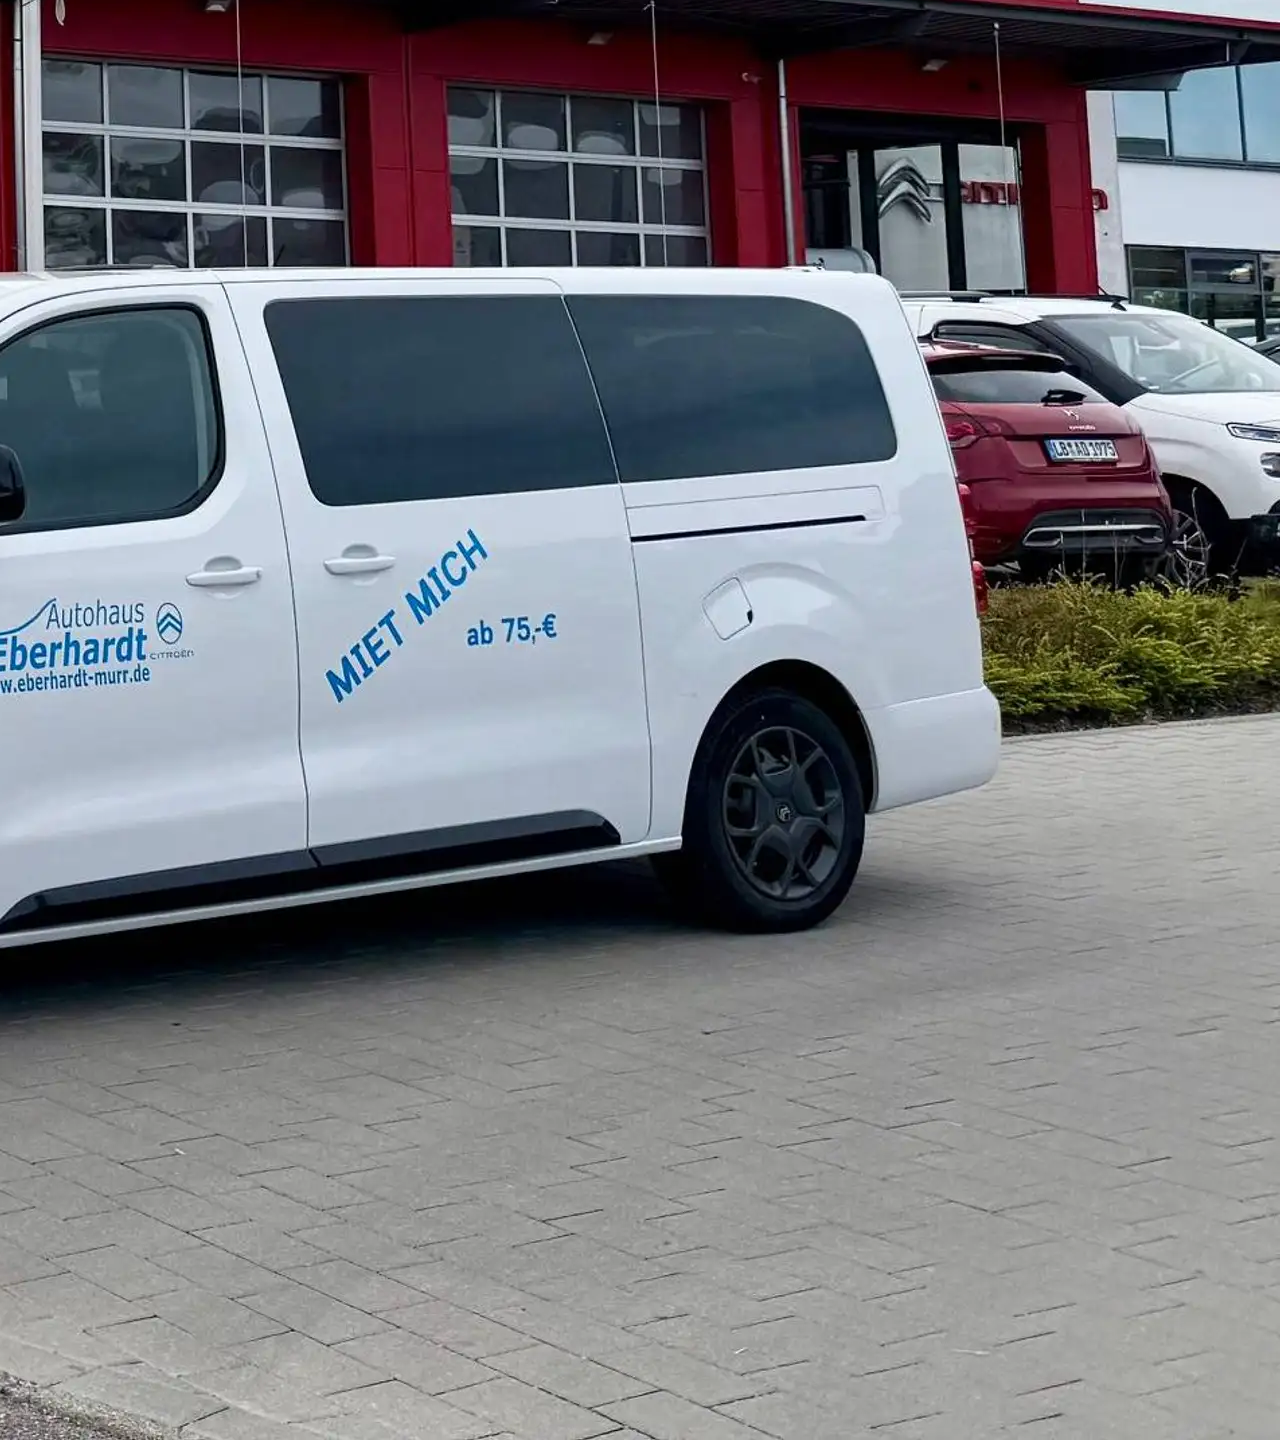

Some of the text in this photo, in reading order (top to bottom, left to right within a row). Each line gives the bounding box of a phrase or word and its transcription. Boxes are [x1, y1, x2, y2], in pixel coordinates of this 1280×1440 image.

[45, 599, 145, 629] Autohaus
[325, 528, 488, 703] MIET MICH
[467, 613, 557, 646] ab 75,-€
